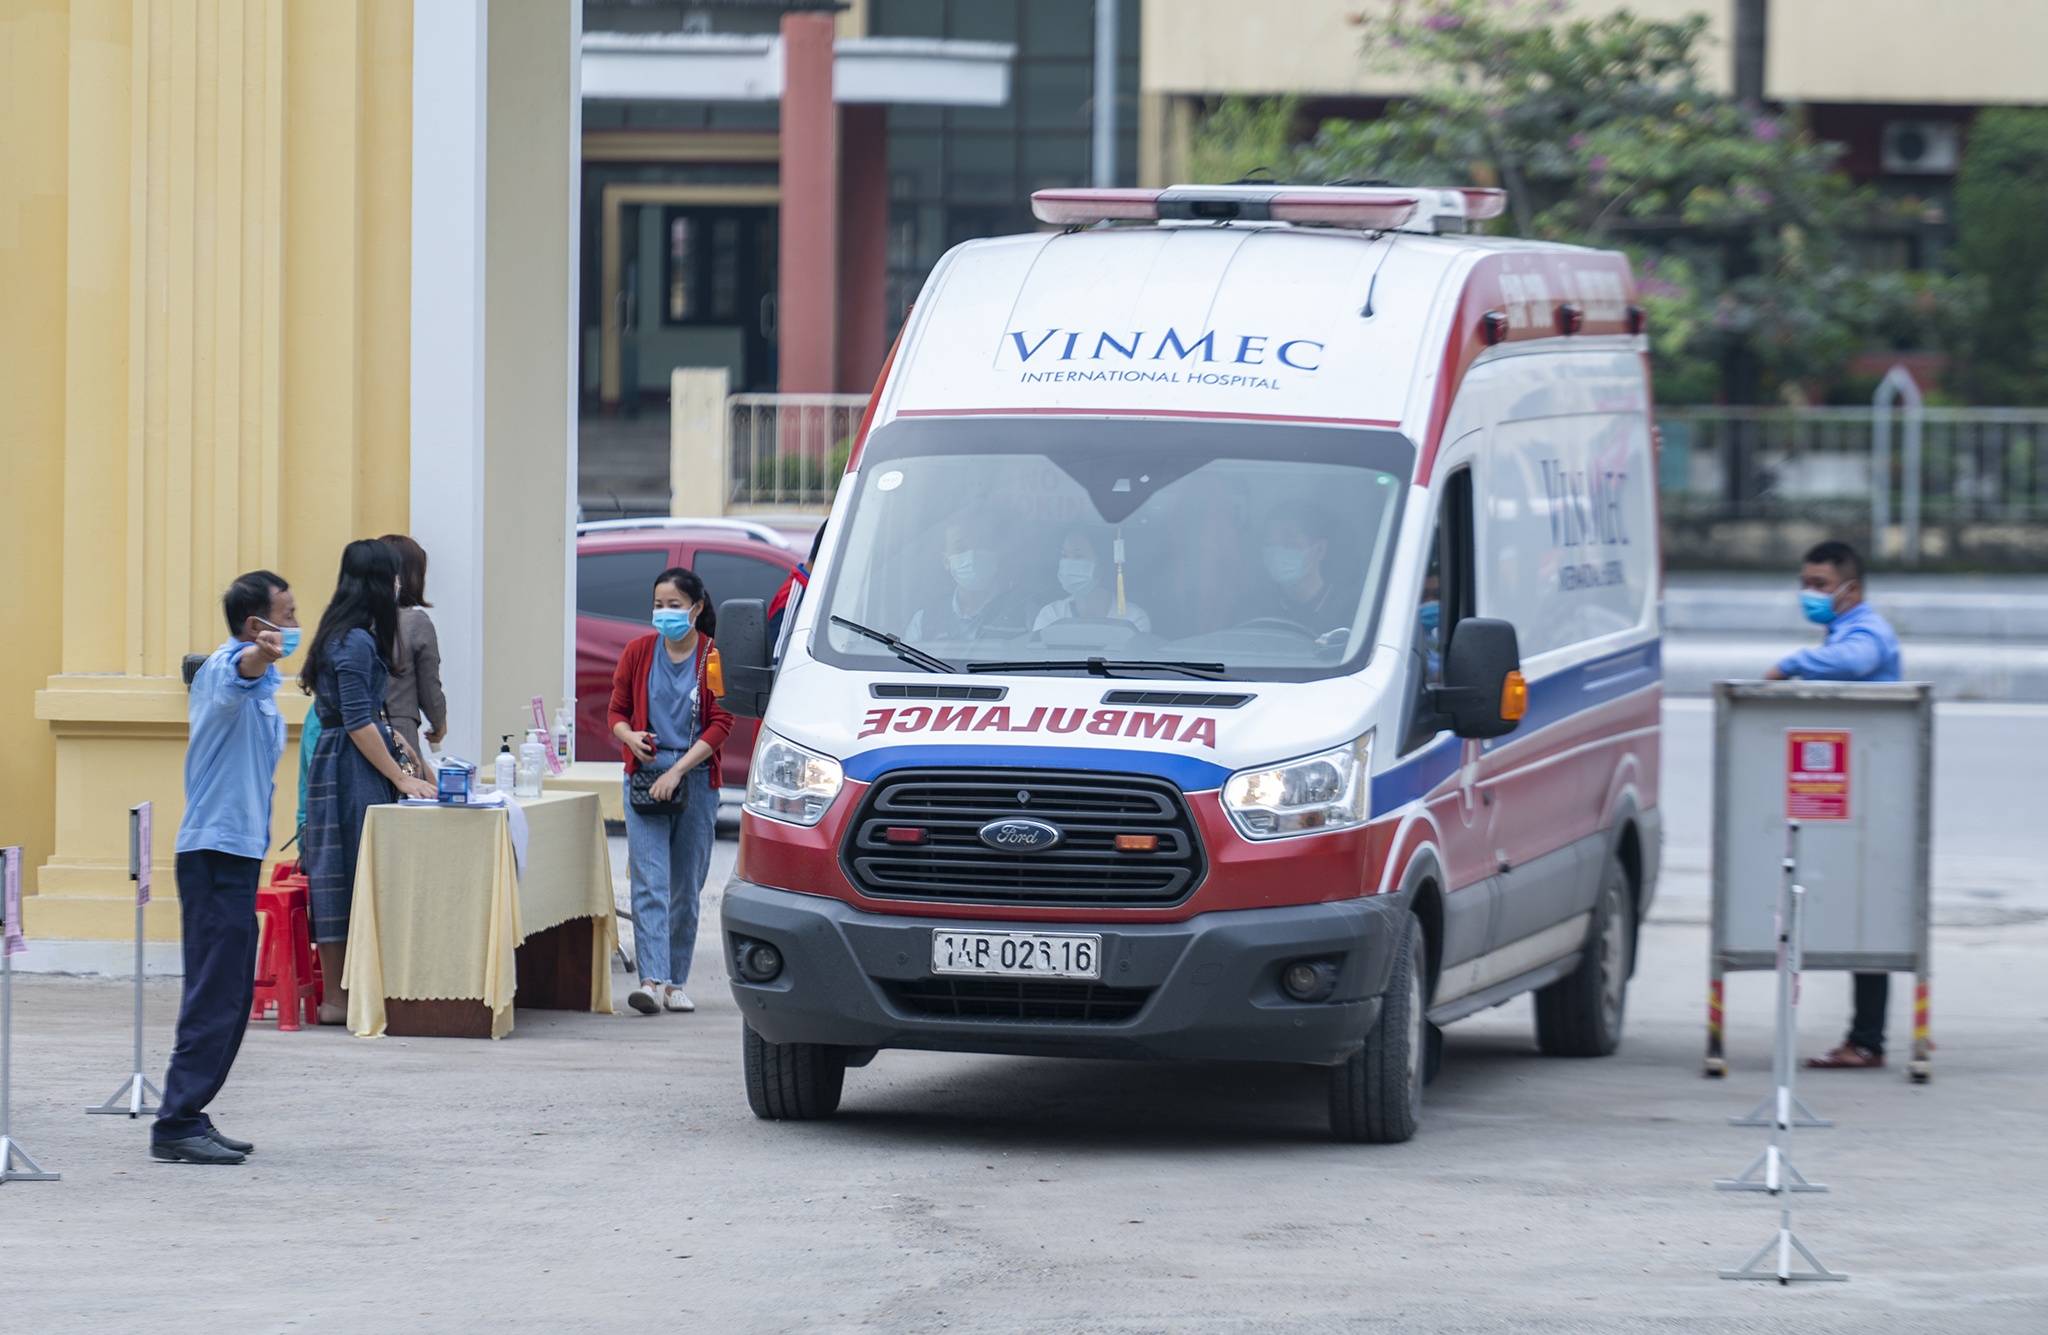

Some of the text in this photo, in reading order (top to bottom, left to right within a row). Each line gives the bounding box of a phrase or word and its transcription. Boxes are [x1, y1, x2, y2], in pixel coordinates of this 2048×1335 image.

[1006, 326, 1325, 371] VINMEC
[1020, 370, 1281, 391] INTERNATIONAL HOSPITAL
[996, 824, 1039, 844] Ford
